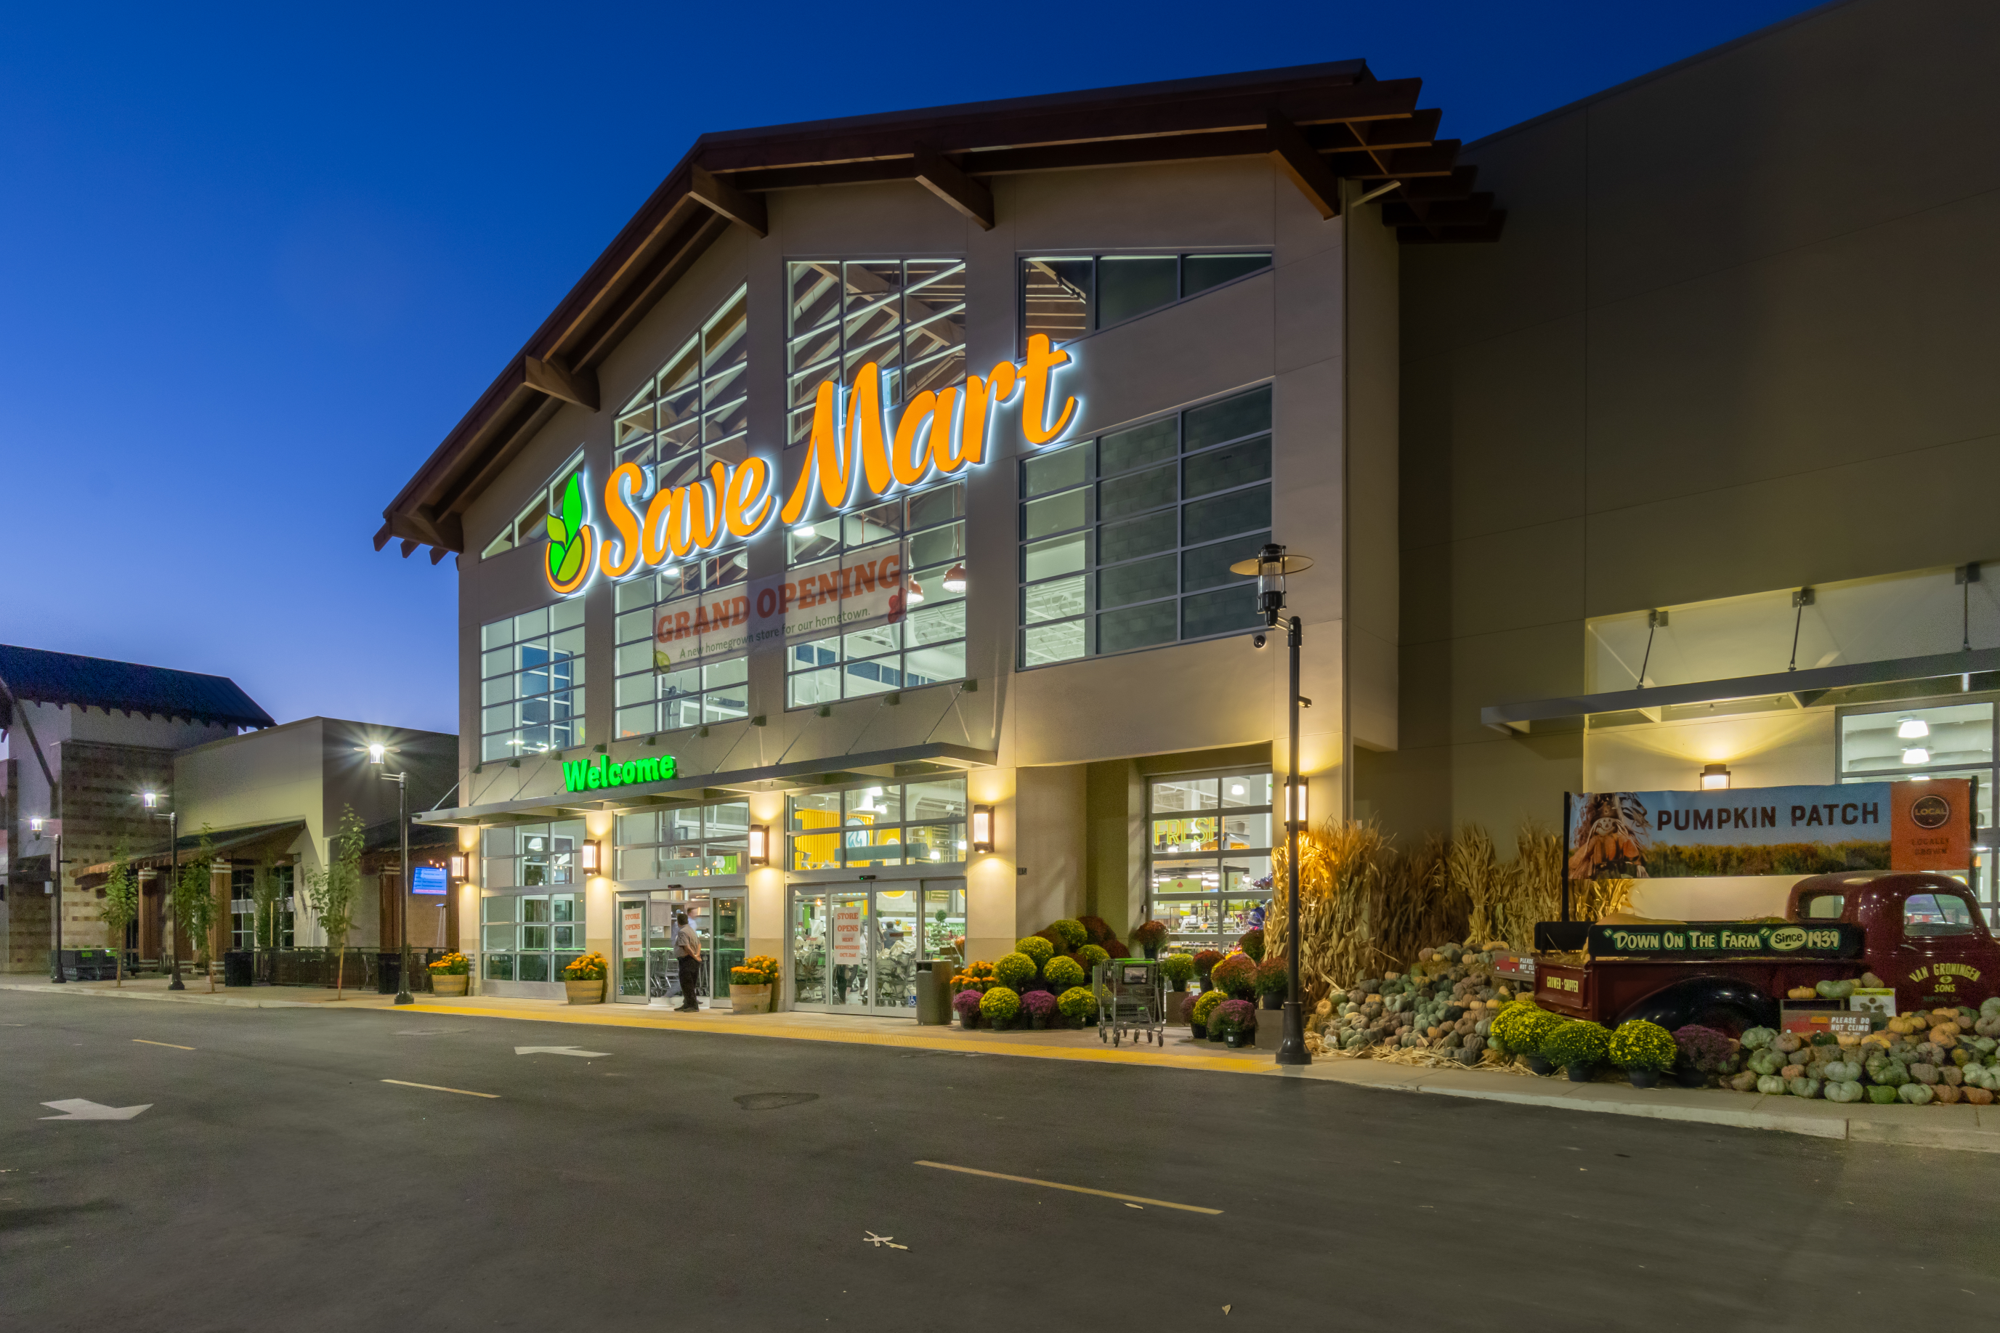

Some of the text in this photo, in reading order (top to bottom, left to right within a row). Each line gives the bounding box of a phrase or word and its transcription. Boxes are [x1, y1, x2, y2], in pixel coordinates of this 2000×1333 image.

[599, 333, 1078, 578] Save Mart
[657, 554, 901, 644] GRAND OPENING
[680, 608, 871, 659] A new homegrown store for our hometown.
[562, 754, 677, 792] Welcome
[1657, 802, 1879, 831] PUMPKIN PATCH
[1914, 807, 1948, 816] LOCAL
[625, 912, 641, 920] STORE
[837, 912, 859, 920] STORE
[625, 923, 641, 931] OPENS
[837, 924, 859, 932] OPENS
[1663, 932, 1685, 949] ON
[1688, 931, 1716, 948] THE
[1774, 932, 1803, 944] Since
[1806, 931, 1840, 949] 1939
[1909, 962, 1981, 983] VAN GRONINGEN
[1934, 984, 1956, 993] SONS
[1848, 1024, 1869, 1032] CLIMB
